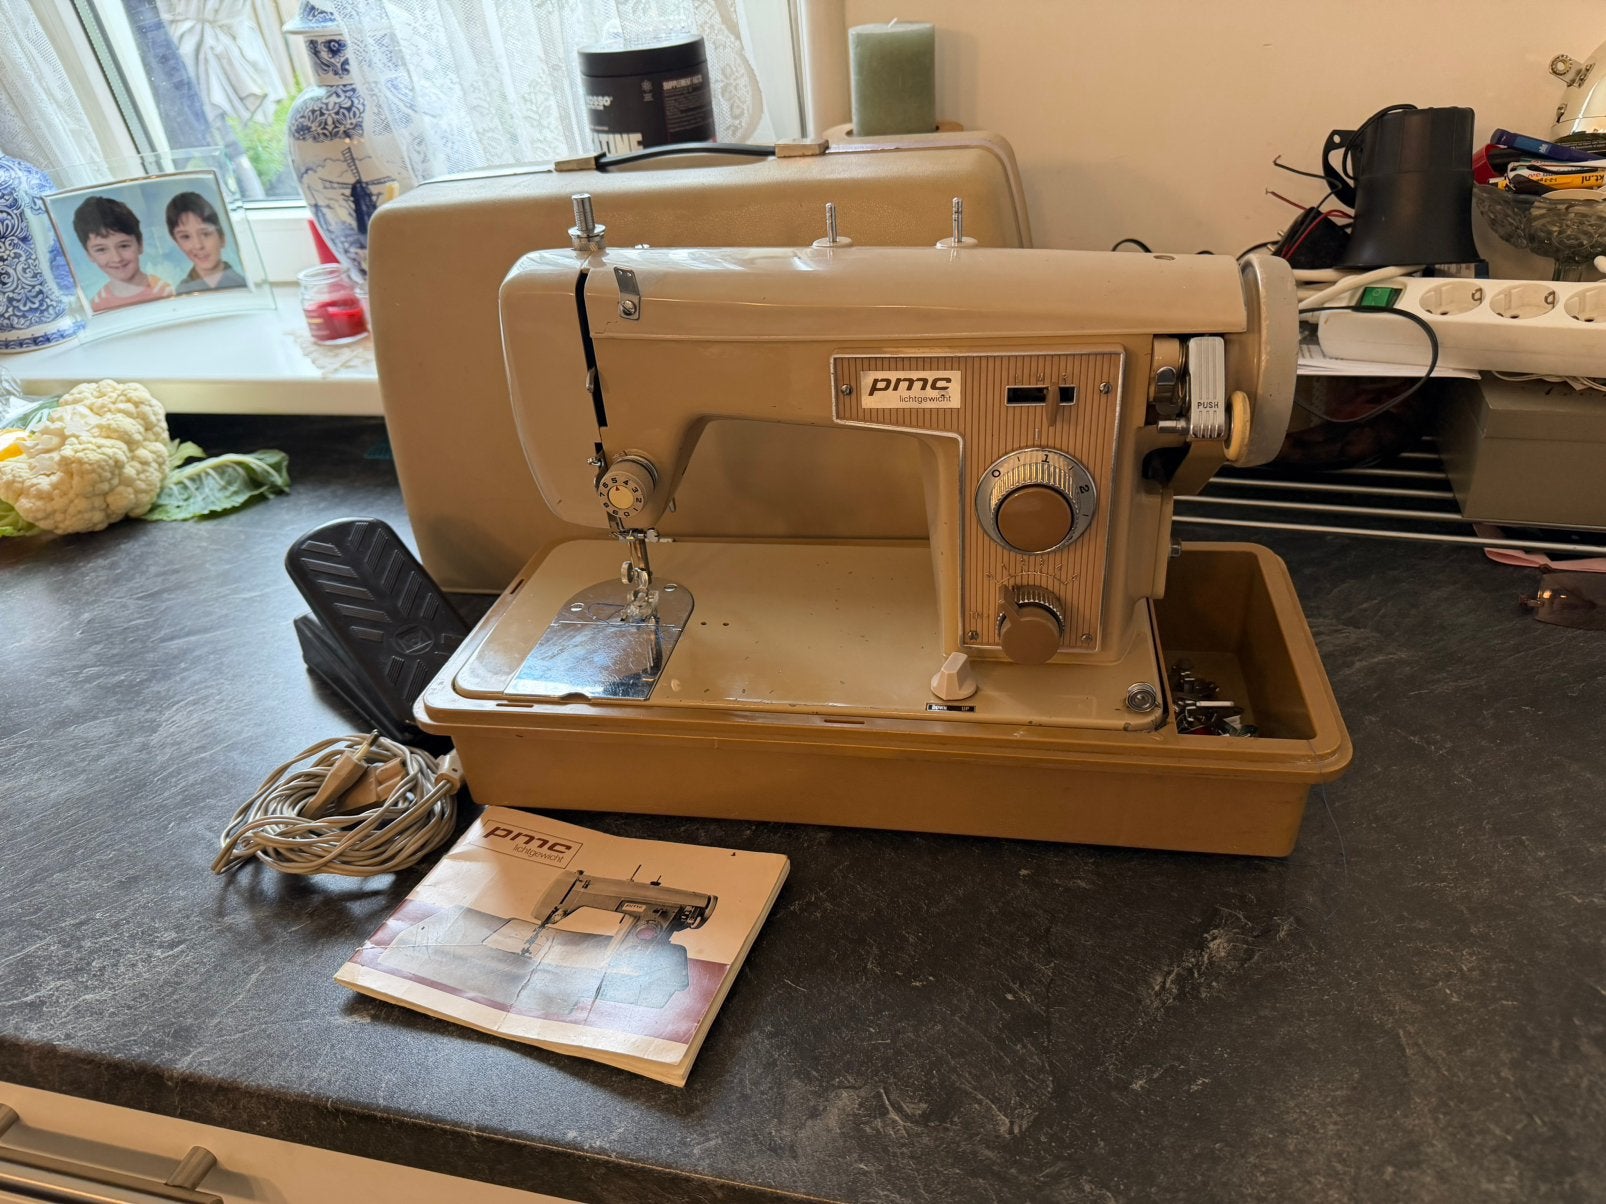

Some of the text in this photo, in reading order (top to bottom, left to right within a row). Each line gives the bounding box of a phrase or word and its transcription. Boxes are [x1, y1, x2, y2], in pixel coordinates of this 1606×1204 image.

[867, 377, 952, 397] pmc
[899, 395, 952, 405] lichtgewicht
[1197, 401, 1219, 409] PUSH
[1041, 453, 1050, 464] 1
[1079, 484, 1090, 494] 2
[483, 826, 573, 854] pmc
[513, 843, 565, 863] lichtgewicht
